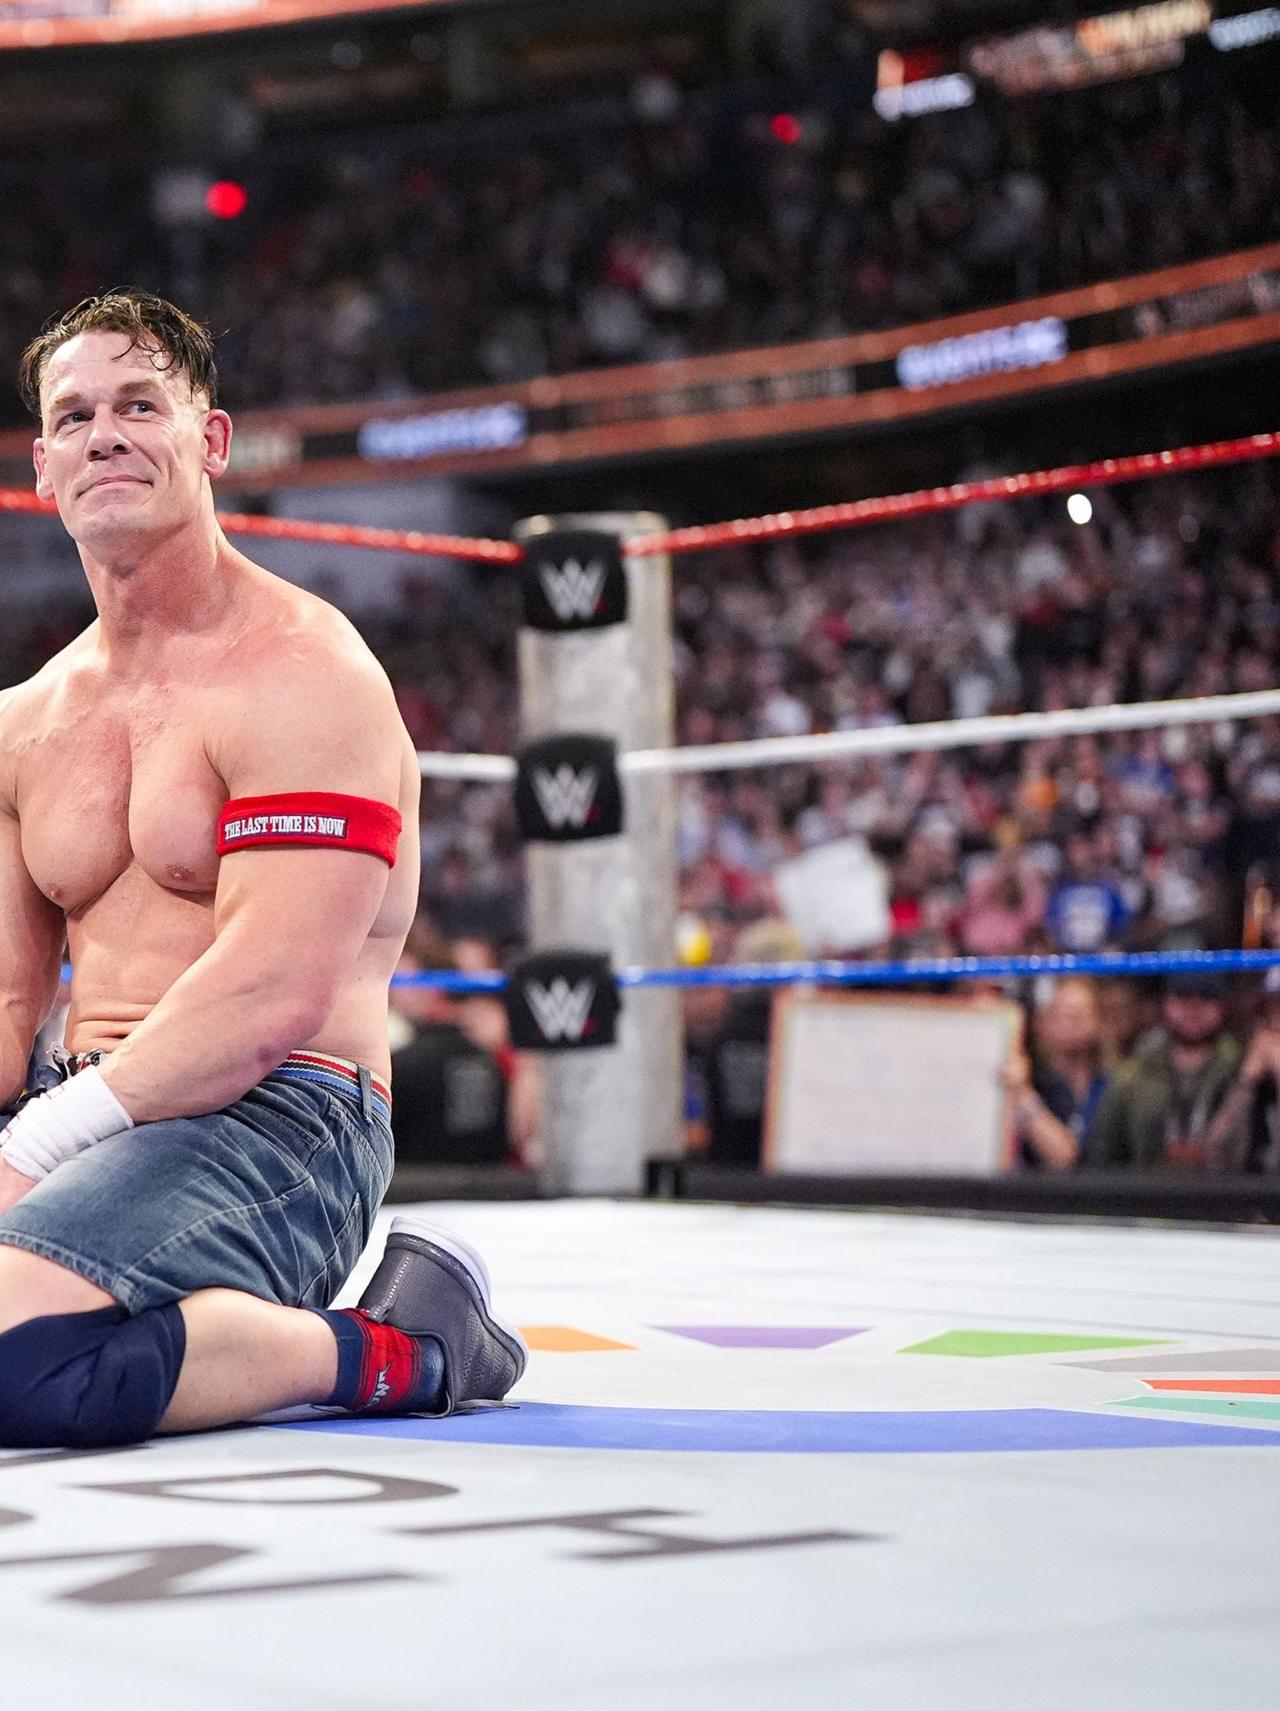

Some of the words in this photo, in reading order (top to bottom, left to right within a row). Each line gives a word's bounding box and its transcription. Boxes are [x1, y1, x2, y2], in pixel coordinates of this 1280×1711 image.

[225, 820, 240, 840] THE
[241, 817, 268, 836] LAST
[270, 816, 301, 833] TIME
[304, 816, 316, 833] IS
[318, 817, 346, 836] NOW
